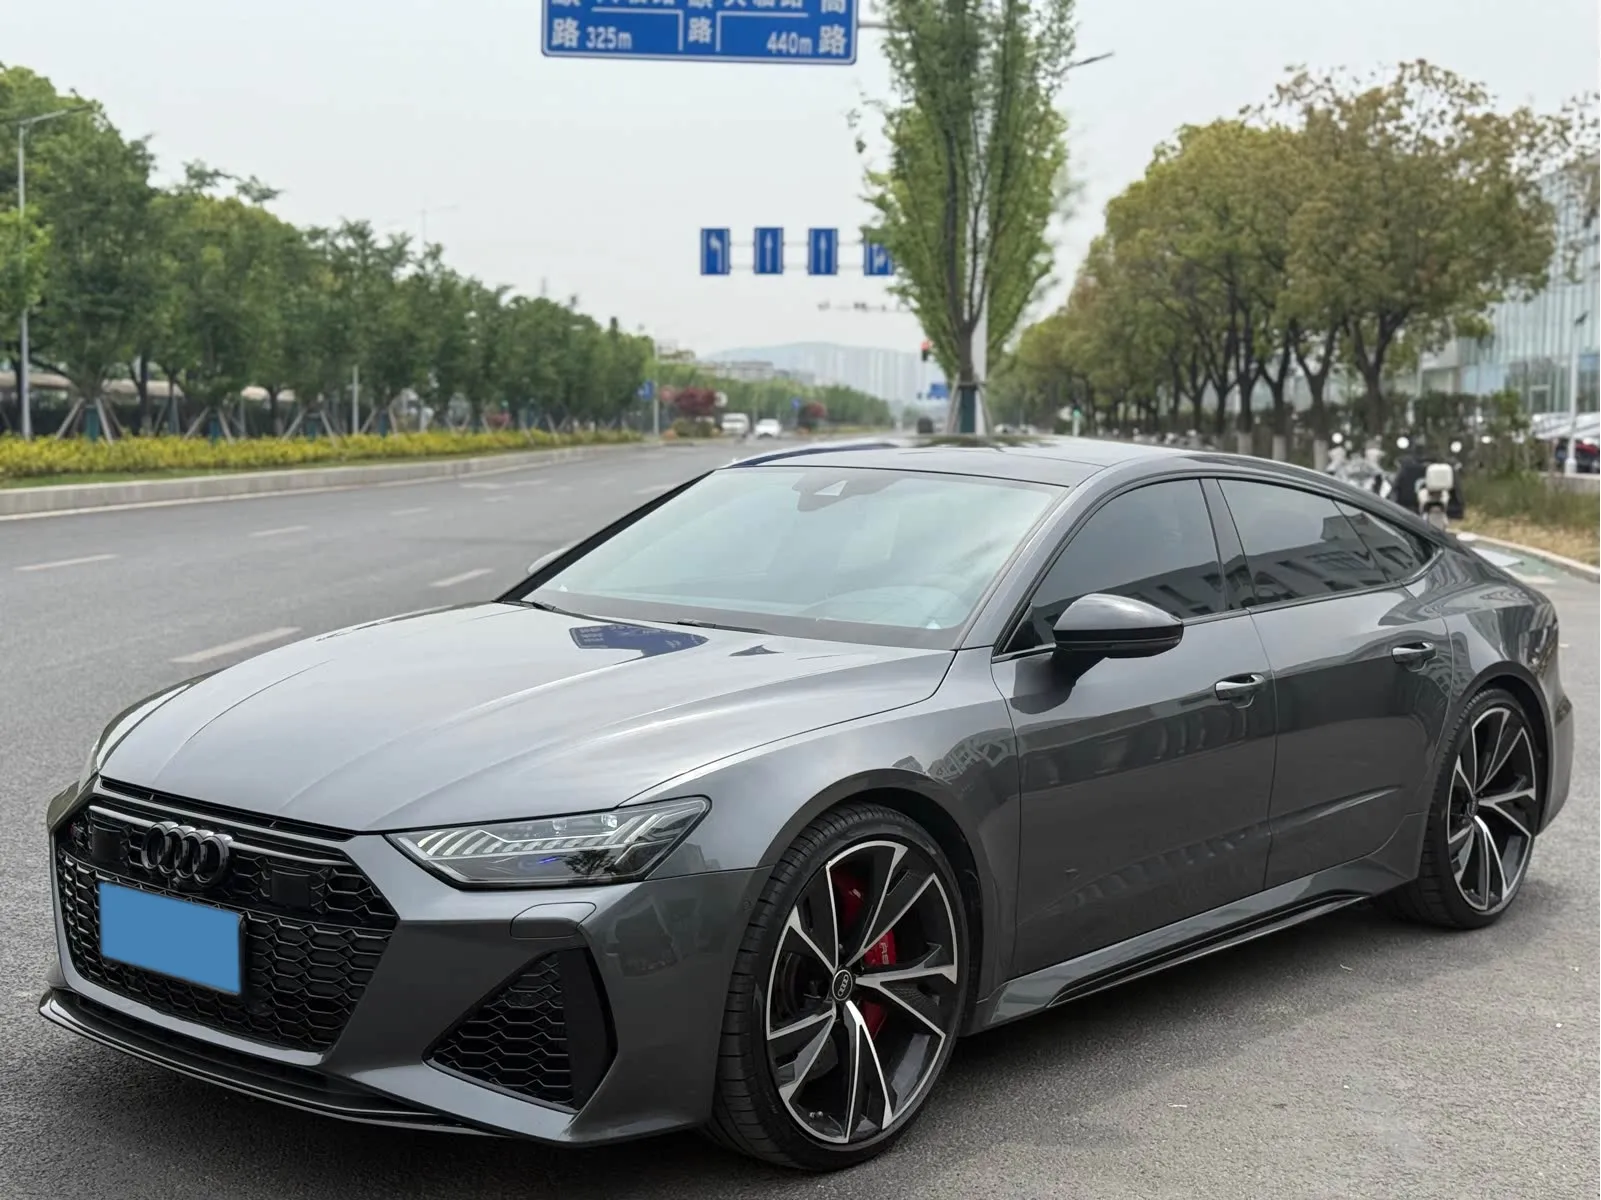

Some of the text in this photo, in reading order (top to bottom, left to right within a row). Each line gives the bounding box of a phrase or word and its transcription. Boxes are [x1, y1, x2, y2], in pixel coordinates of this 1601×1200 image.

[551, 0, 581, 48] 路
[585, 26, 633, 49] 325m
[766, 31, 813, 54] 440m
